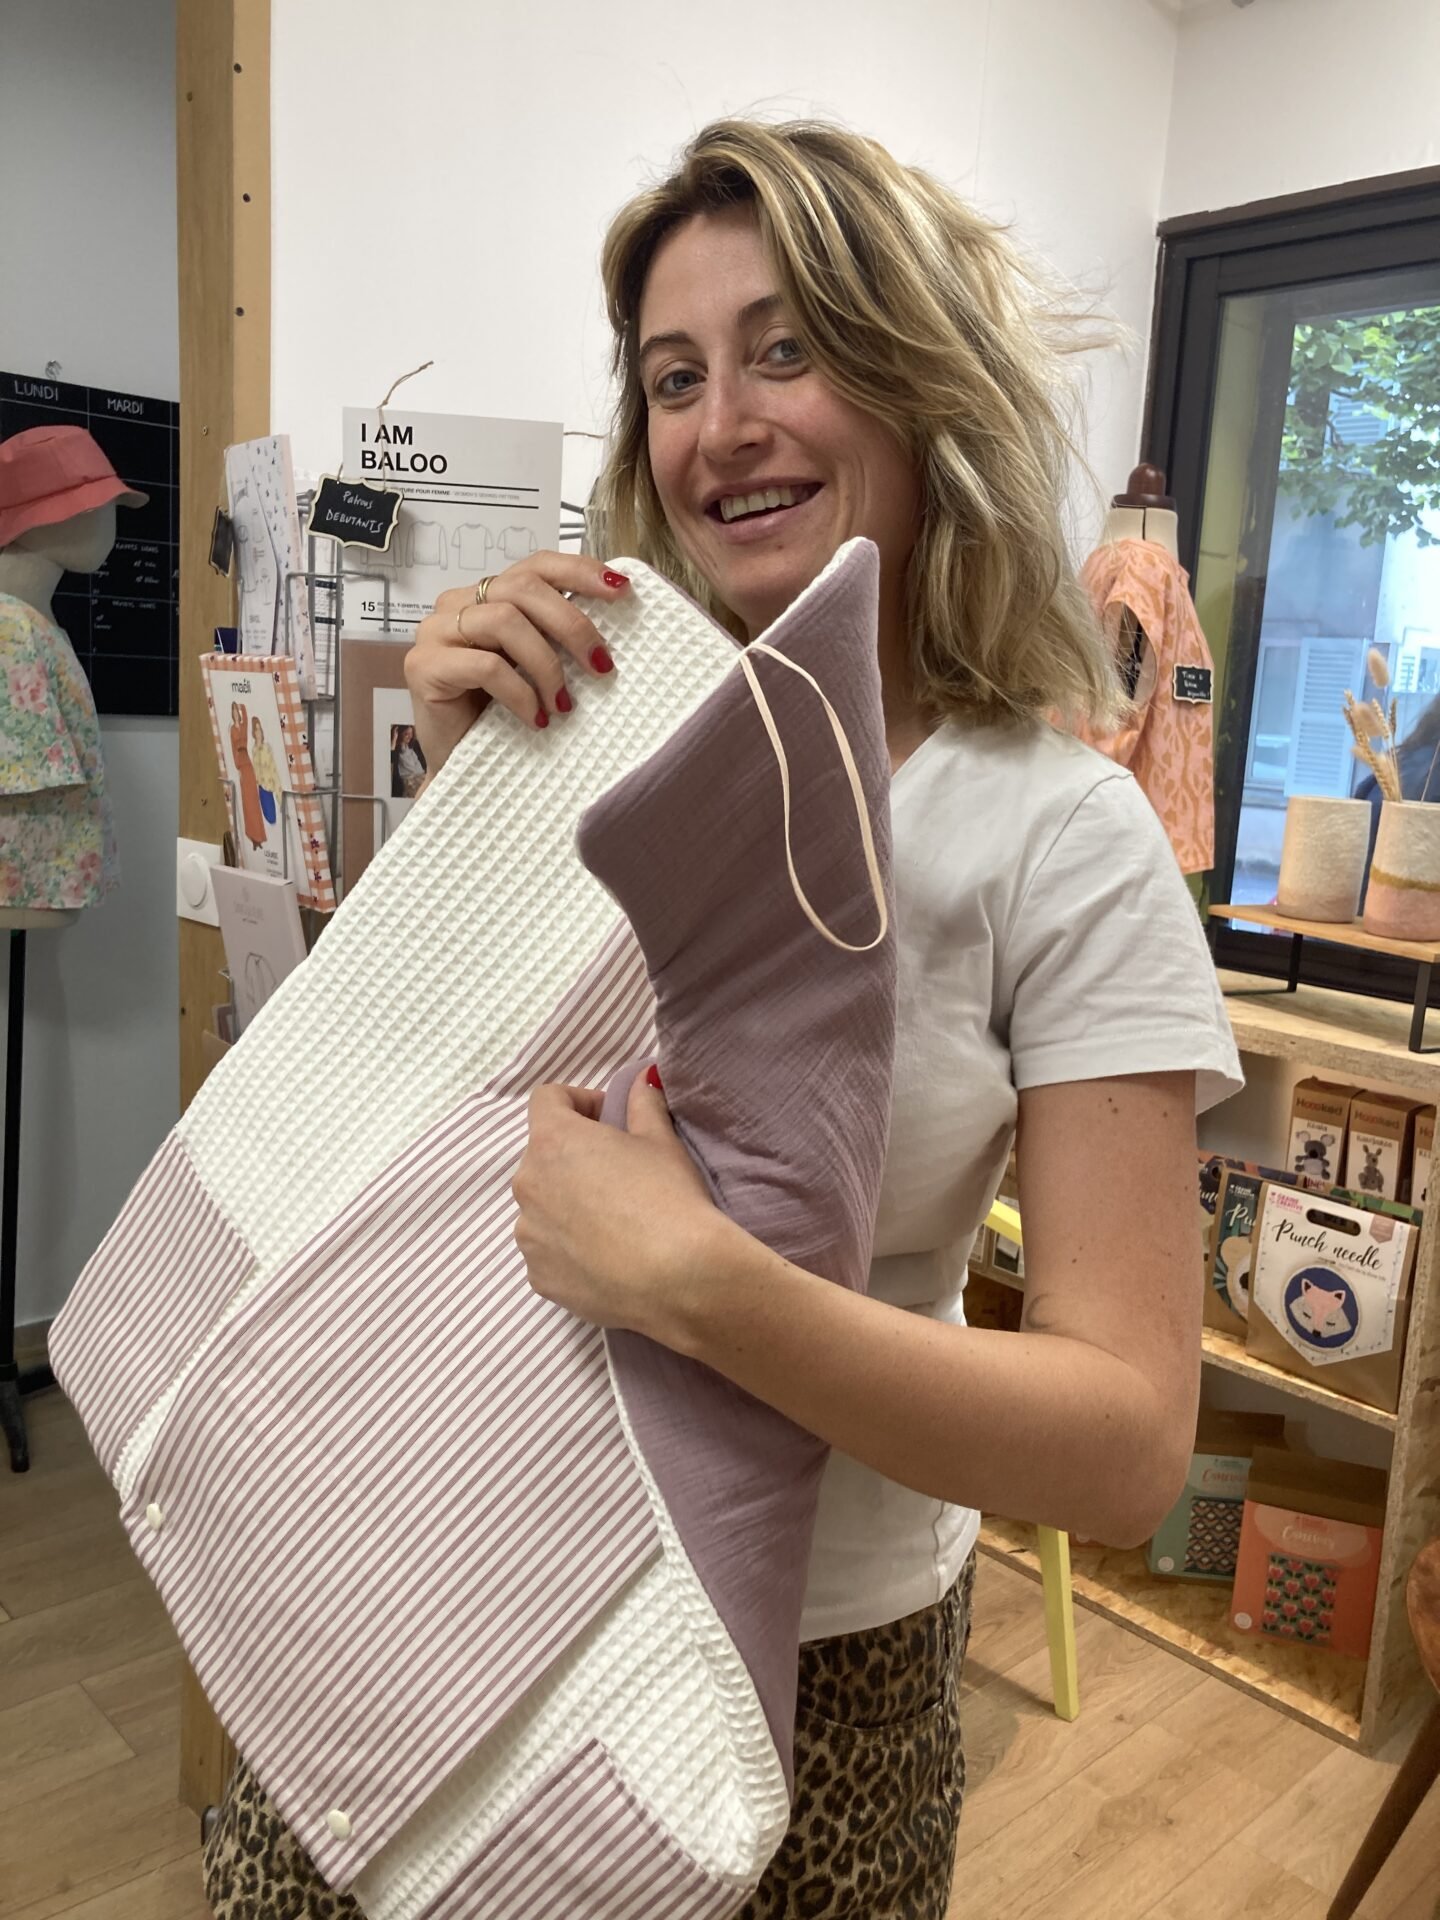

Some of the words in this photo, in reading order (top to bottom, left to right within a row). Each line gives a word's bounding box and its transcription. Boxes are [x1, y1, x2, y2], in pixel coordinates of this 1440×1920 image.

[14, 380, 59, 401] LUNDI
[107, 398, 144, 415] MARDI
[361, 423, 367, 442] I
[374, 424, 413, 445] AM
[361, 450, 447, 474] BALOO
[343, 490, 374, 510] Patrons
[325, 508, 384, 534] DEBUTANTS
[361, 601, 376, 612] 15
[1271, 1219, 1328, 1252] Punch
[1332, 1245, 1383, 1271] needle
